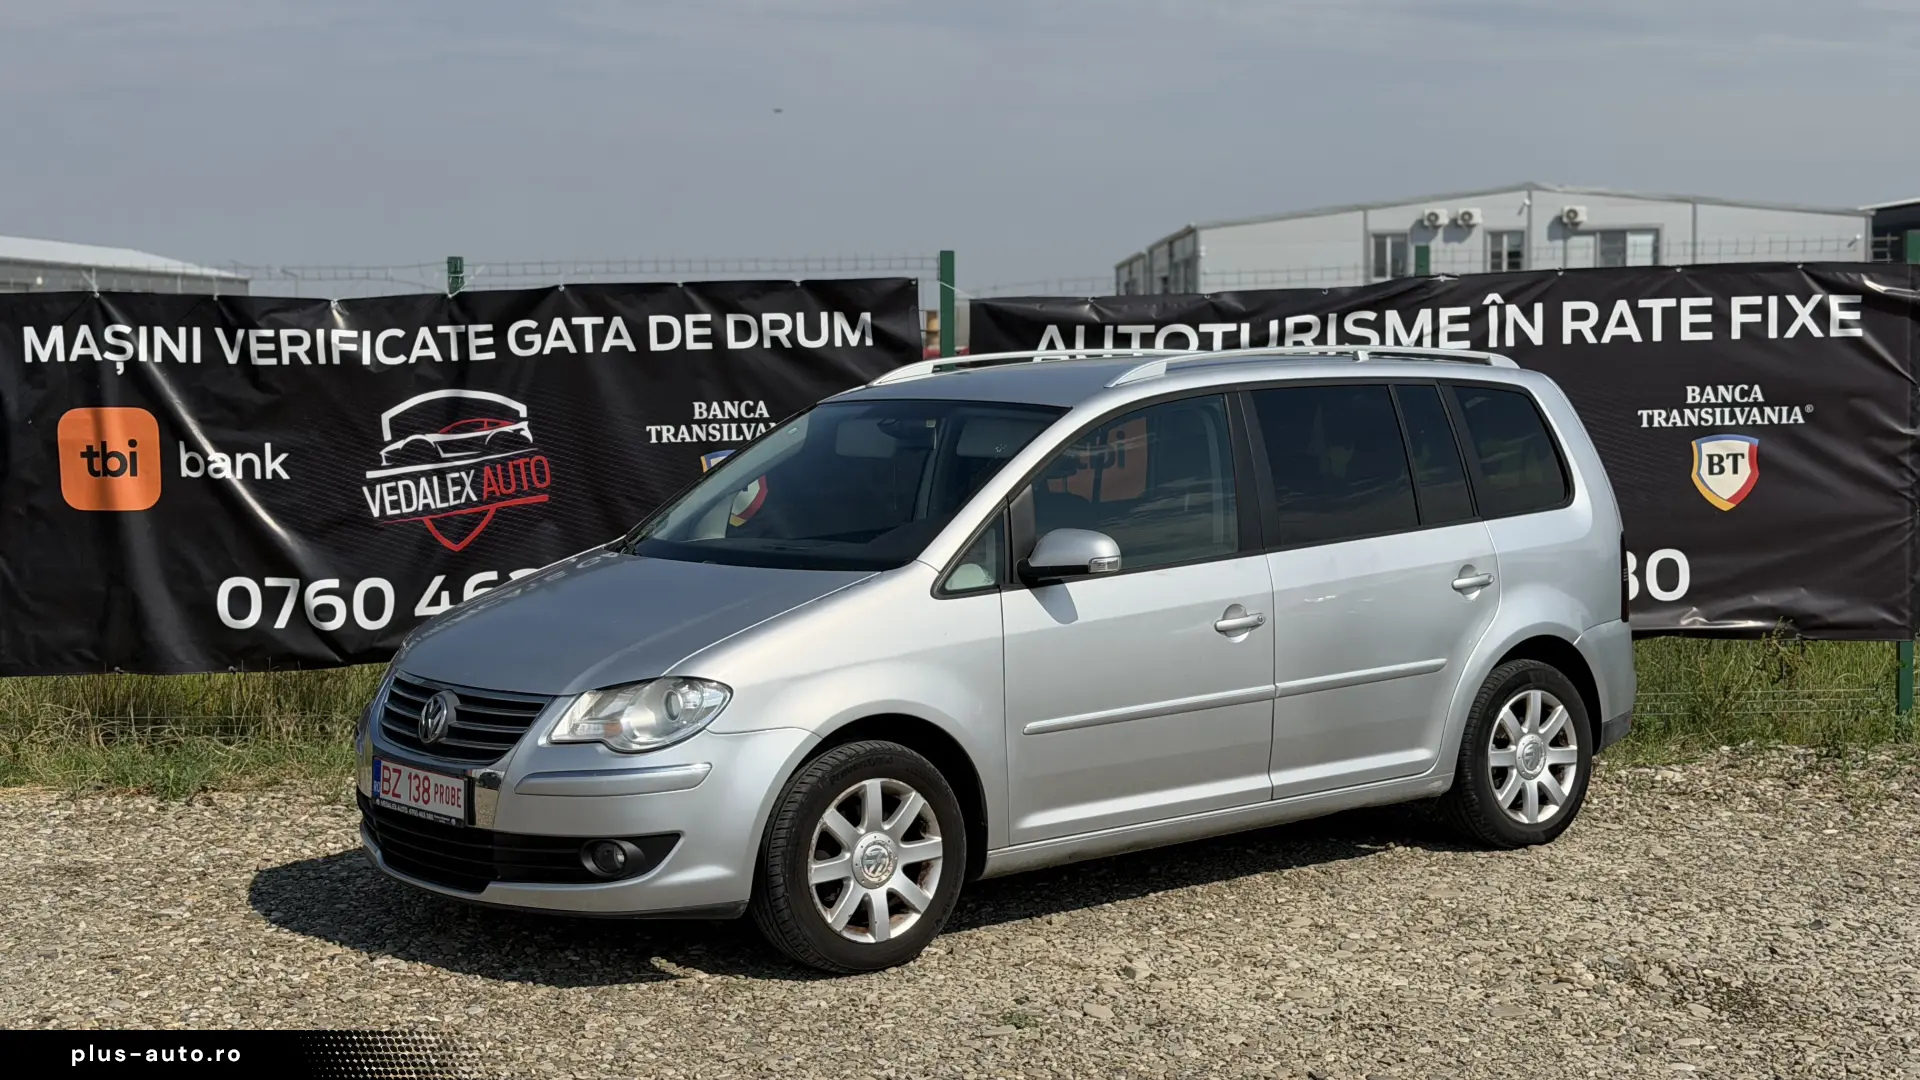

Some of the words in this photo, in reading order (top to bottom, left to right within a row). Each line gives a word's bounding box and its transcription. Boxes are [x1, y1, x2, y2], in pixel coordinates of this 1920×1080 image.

[23, 324, 201, 375] MAȘINI
[215, 324, 496, 366] VERIFICATE
[507, 316, 636, 356] GATA
[648, 313, 713, 352] DE
[726, 311, 874, 349] DRUM
[1032, 306, 1471, 362] AUTOTURISME
[1482, 292, 1544, 348] ÎN
[1562, 297, 1714, 345] RATE
[1730, 294, 1864, 340] FIXE
[692, 400, 770, 420] BANCA
[1685, 384, 1765, 404] BANCA
[80, 438, 138, 478] tbi
[179, 442, 291, 480] bank
[1706, 452, 1745, 476] BT
[362, 469, 478, 518] VEDALEX
[483, 455, 551, 501] AUTO
[216, 576, 395, 631] 0760
[414, 568, 538, 616] 46
[381, 765, 402, 799] BZ
[408, 771, 431, 805] 138
[433, 782, 462, 808] PROBE
